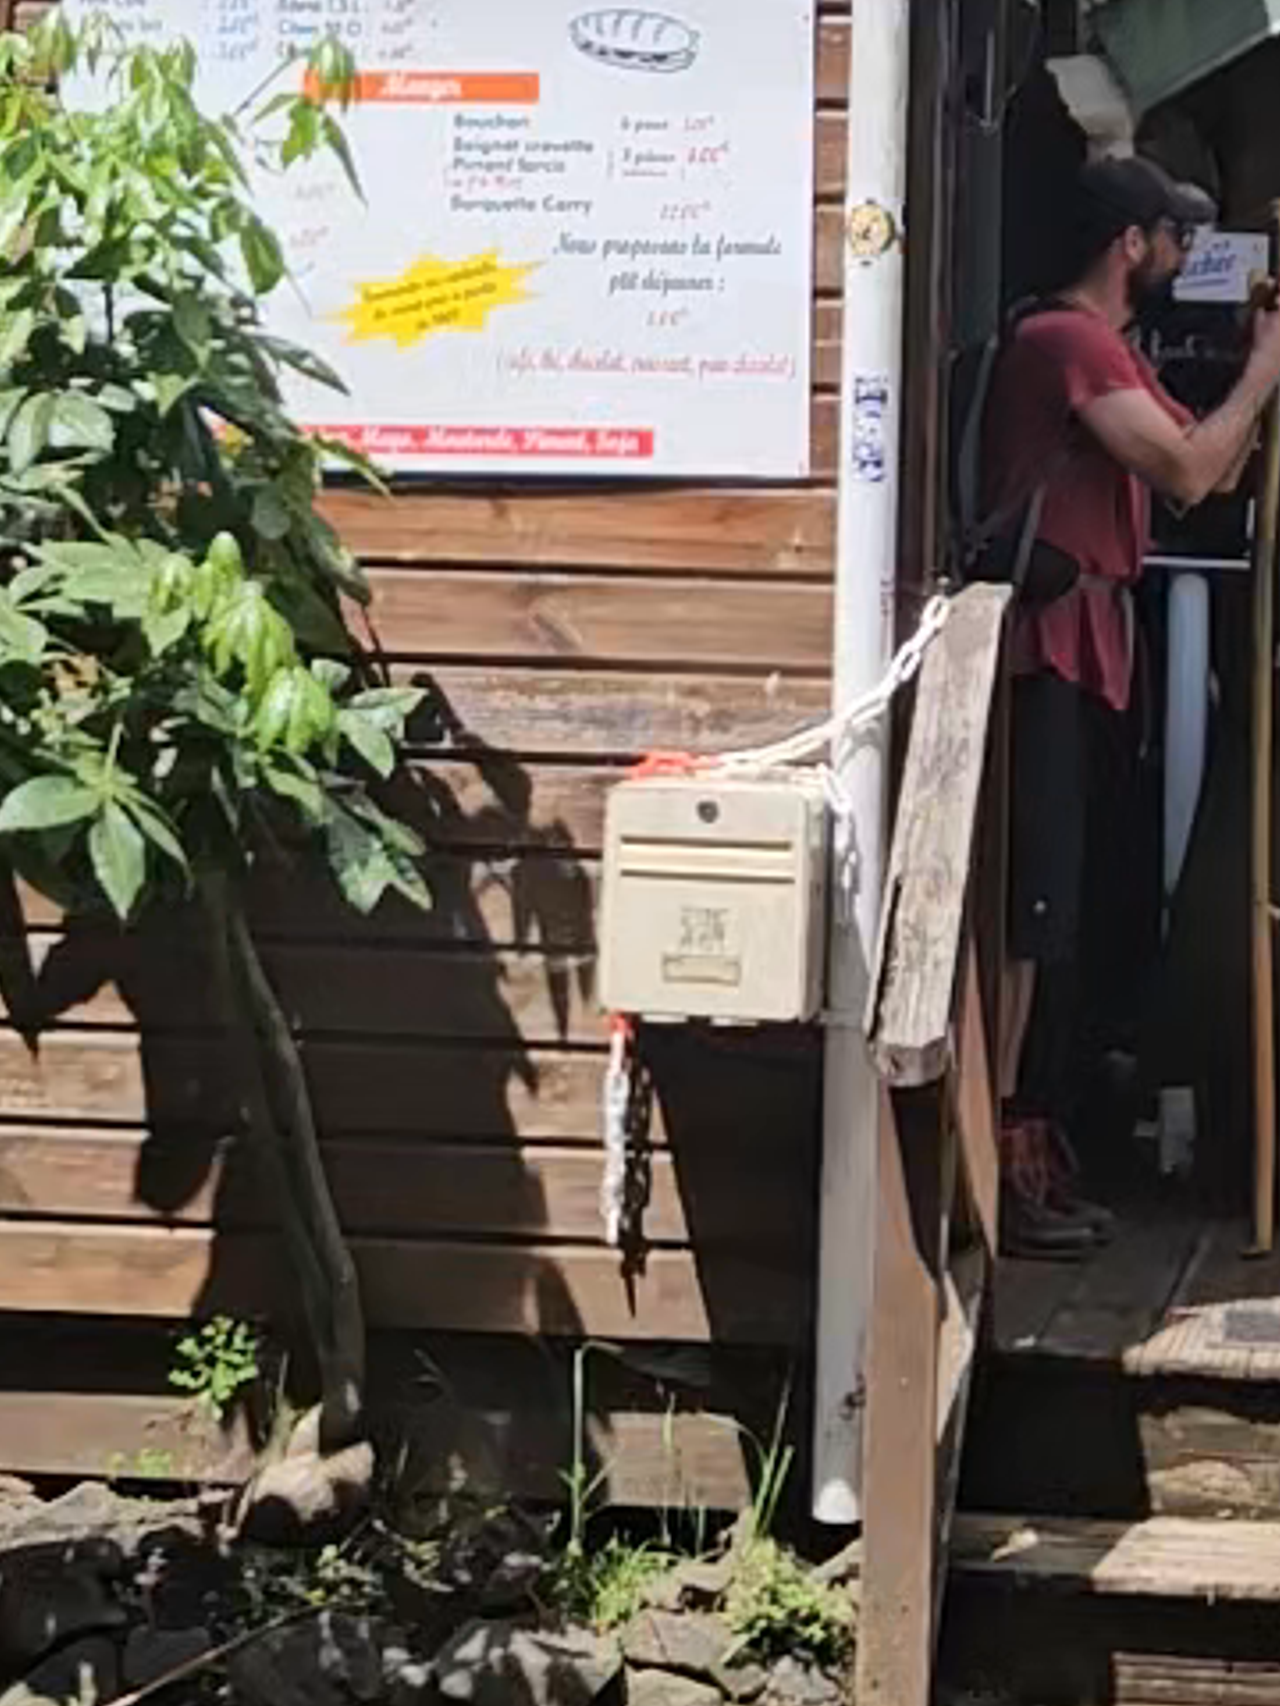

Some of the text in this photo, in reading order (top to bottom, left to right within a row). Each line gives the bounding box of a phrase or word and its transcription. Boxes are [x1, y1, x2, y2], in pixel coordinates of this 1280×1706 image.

[454, 113, 529, 128] Bouchon
[453, 137, 594, 155] Beignet crevette
[452, 158, 513, 174] Piment
[451, 195, 593, 216] Barquette Carry
